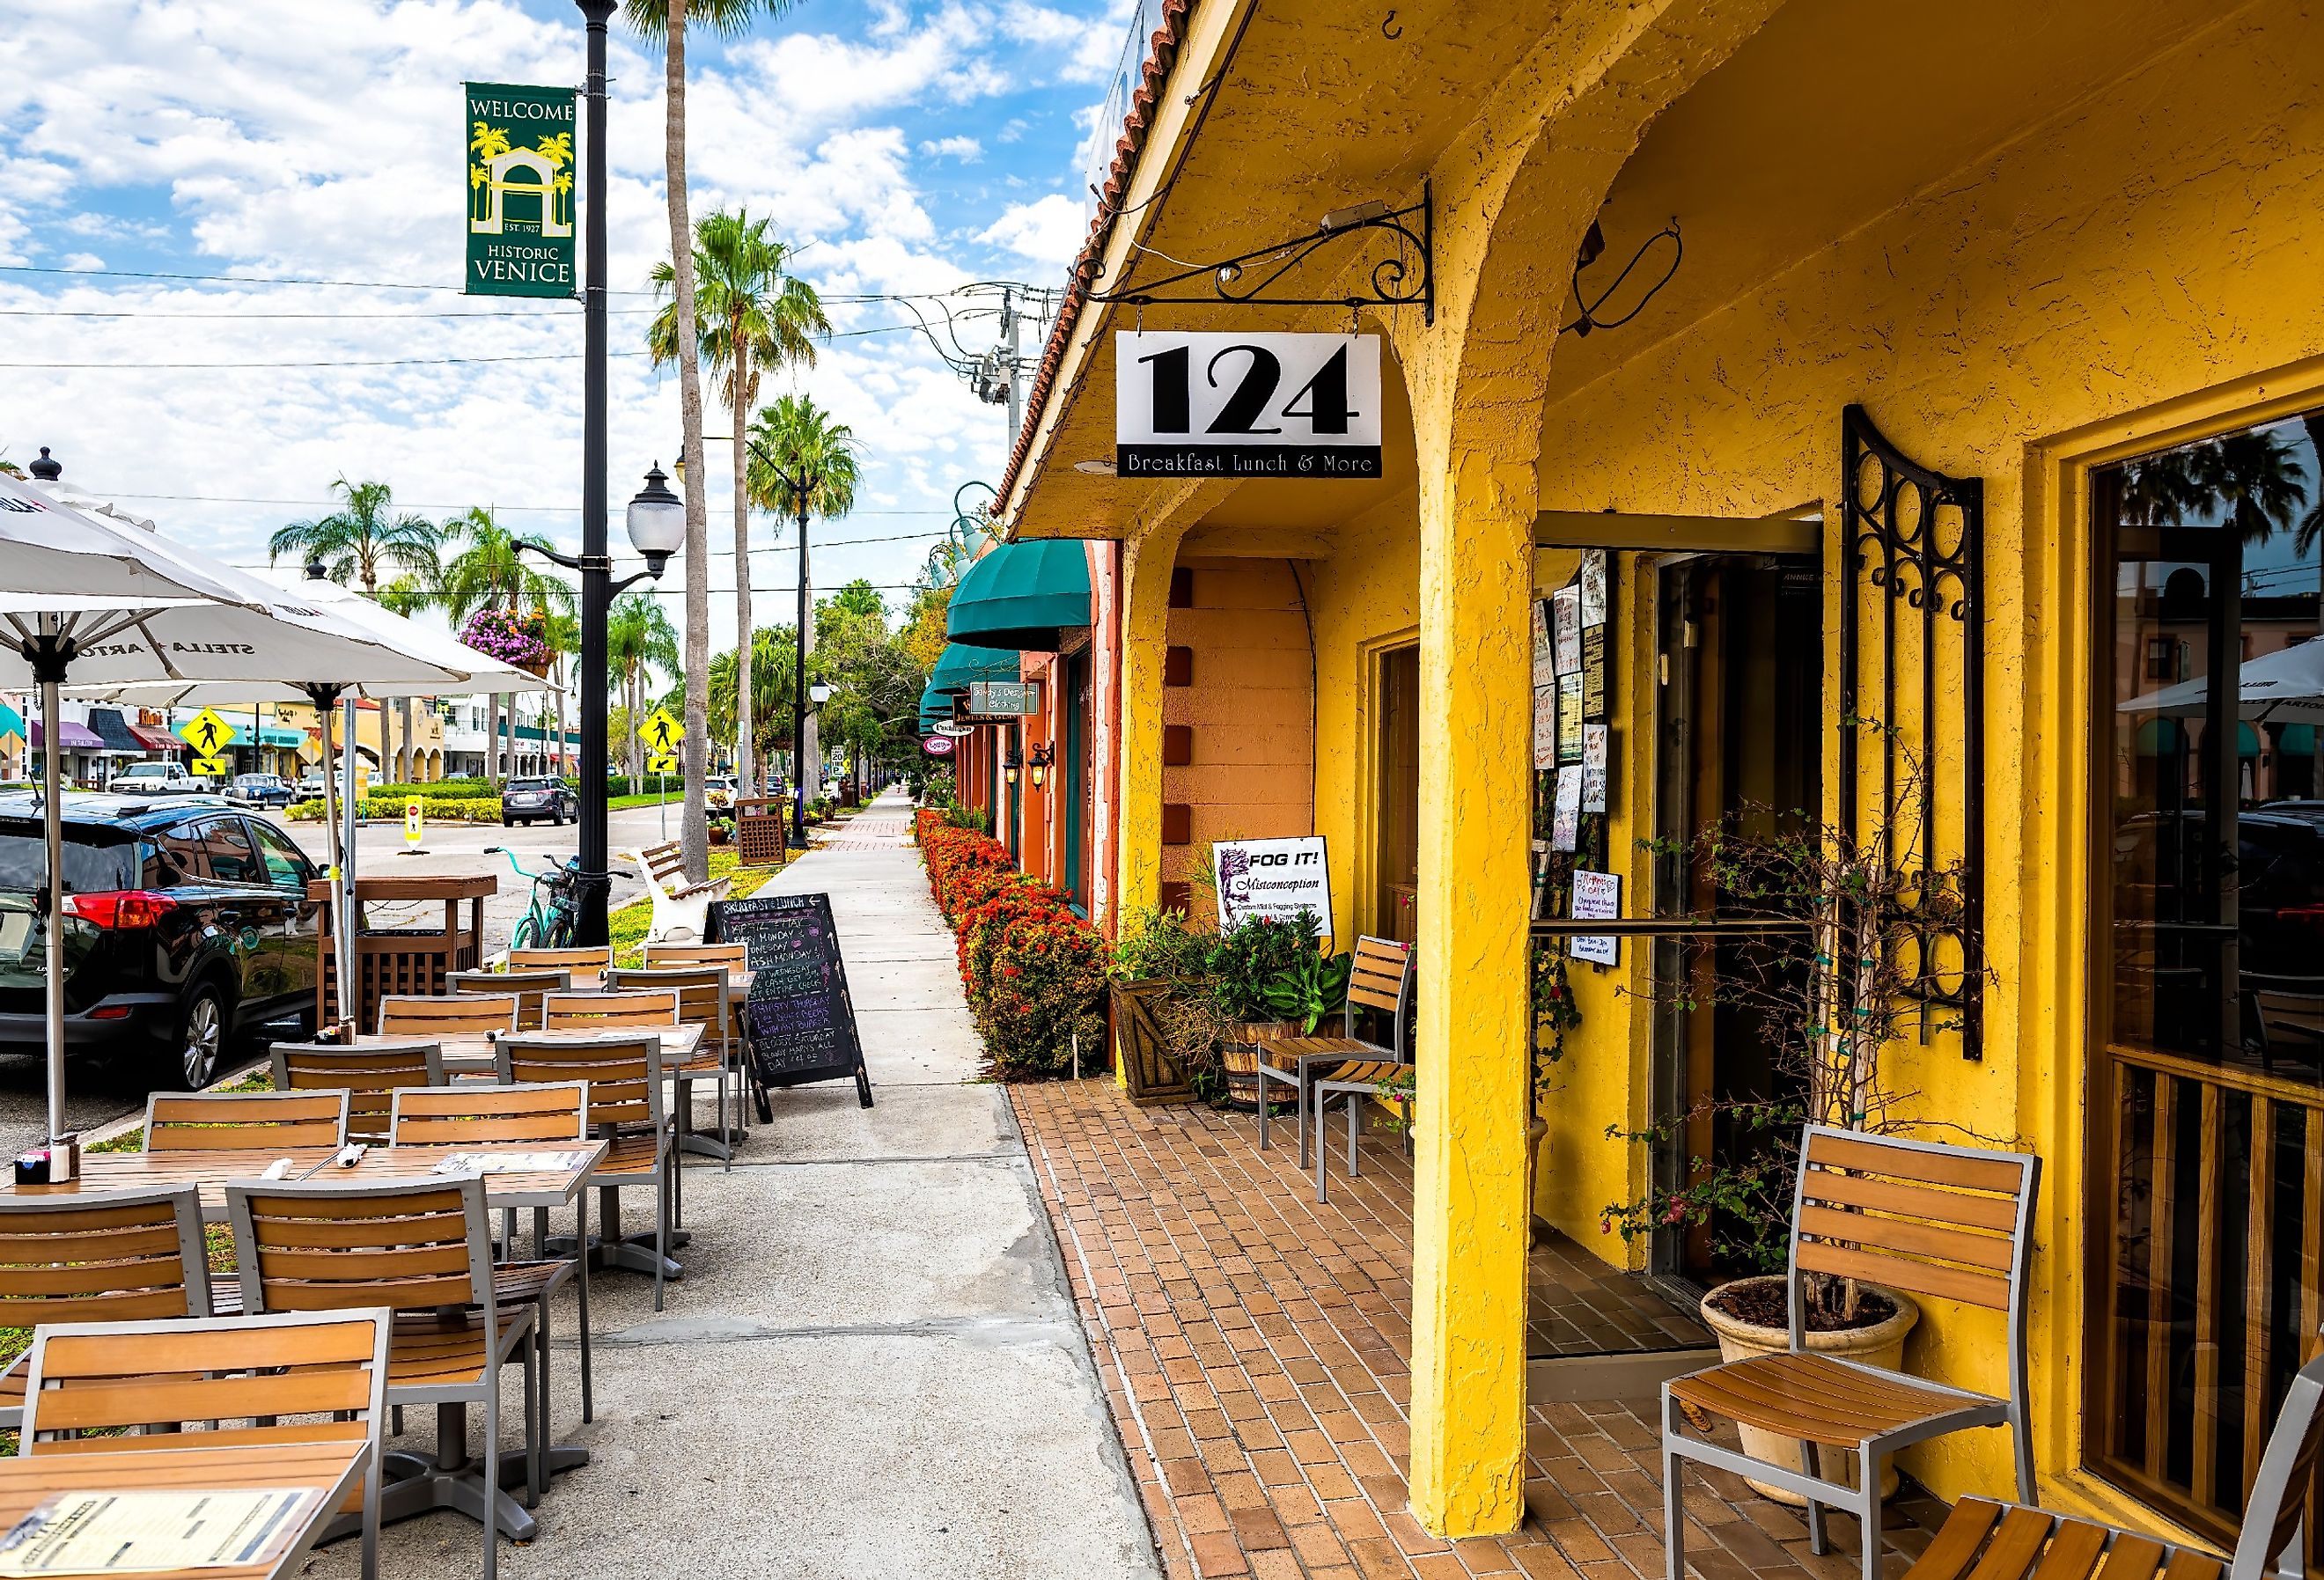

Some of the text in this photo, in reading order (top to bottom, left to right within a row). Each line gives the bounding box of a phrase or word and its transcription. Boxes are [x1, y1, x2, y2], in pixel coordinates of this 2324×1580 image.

[470, 99, 573, 121] WELCOME
[504, 223, 541, 234] EST. 1927
[488, 245, 559, 261] HISTORIC
[474, 260, 570, 283] VENICE
[1137, 342, 1360, 435] 124
[1129, 452, 1373, 473] Breakfast Lunch & More
[989, 699, 1019, 711] Clothing
[956, 713, 985, 722] JEWELS
[985, 713, 993, 722] &
[1249, 851, 1320, 867] FOG IT!
[723, 900, 769, 915] BREAKFAST
[777, 895, 805, 910] LUNCH
[1273, 902, 1293, 911] Fogging
[759, 930, 794, 943] MONDAY
[775, 948, 812, 963] MONDAY
[769, 964, 810, 978] WEDNESDAY
[765, 977, 784, 988] CASH
[759, 1029, 835, 1051] BLOODY SATURDAY
[818, 1040, 835, 1050] ALL
[768, 1057, 786, 1070] DAY
